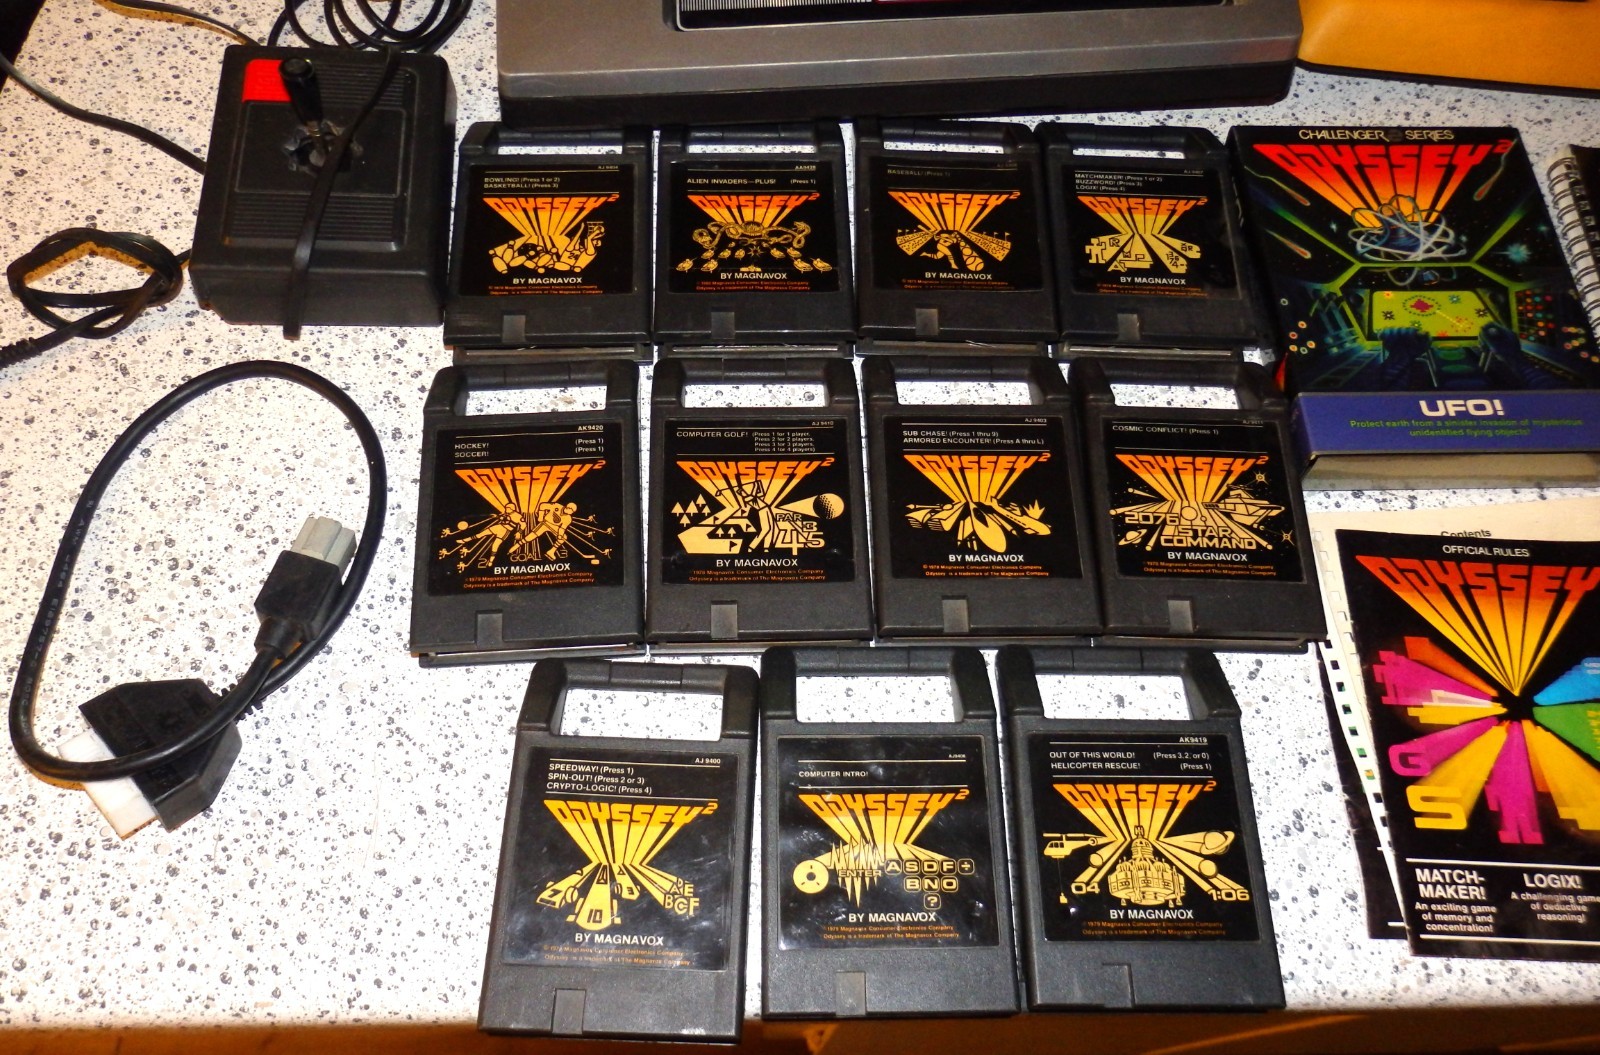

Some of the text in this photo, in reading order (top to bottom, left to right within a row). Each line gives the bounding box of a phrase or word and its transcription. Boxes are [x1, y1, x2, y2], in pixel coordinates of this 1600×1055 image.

[1298, 129, 1454, 142] CHALLENGER SERIES
[720, 272, 787, 280] BY MAGNAVOX
[924, 271, 992, 280] BY MAGNAVOX
[1134, 277, 1186, 285] MAGNAVOX
[1419, 399, 1505, 417] UFO!
[1350, 420, 1384, 429] Protect
[1386, 420, 1409, 428] earth
[1479, 419, 1516, 427] invasion
[1532, 419, 1583, 428] mysterious
[1145, 426, 1187, 434] CONFLICT!
[1410, 428, 1464, 437] unidentified
[1465, 428, 1493, 438] flying
[776, 513, 803, 522] PAR
[1124, 511, 1180, 525] 2076
[1176, 525, 1235, 538] STAR
[1160, 535, 1257, 549] COMMAND
[1442, 545, 1530, 557] OFFICIAL RULES
[510, 552, 542, 562] GOAL
[948, 554, 1024, 562] BY MAGNAVOX
[1167, 552, 1248, 562] BY MAGNAVOX
[716, 558, 798, 567] BY MAGNAVOX
[494, 563, 570, 575] BY MAGNAVOX
[1049, 751, 1135, 759] OUT OF THIS WORLD!
[1153, 752, 1177, 760] (Press
[1202, 752, 1210, 760] 0)
[549, 763, 634, 775] SPEEDWAY! (Press 1)
[1180, 762, 1204, 770] (Press
[548, 773, 593, 782] SPIN-OUT!
[594, 775, 619, 783] (Press
[798, 770, 841, 778] COMPUTER
[546, 782, 652, 795] CRYPTO-LOGIC! (Press 4)
[838, 869, 882, 877] ENTER
[1415, 868, 1486, 884] MATCH-
[1523, 873, 1583, 889] LOGIX!
[1071, 882, 1100, 894] 04
[1418, 884, 1487, 900] MAKER!
[1208, 889, 1250, 901] 1:06
[1510, 891, 1518, 900] A
[1520, 892, 1574, 903] challenging
[1414, 902, 1498, 914] An exciting game
[1530, 902, 1588, 912] of deductive
[848, 912, 936, 922] BY MAGNAVOX
[1109, 909, 1194, 919] BY MAGNAVOX
[1421, 913, 1494, 924] of memory and
[1536, 912, 1586, 923] reasoning!
[1425, 923, 1494, 933] concentration!
[575, 933, 664, 946] BY MAGNAVOX
